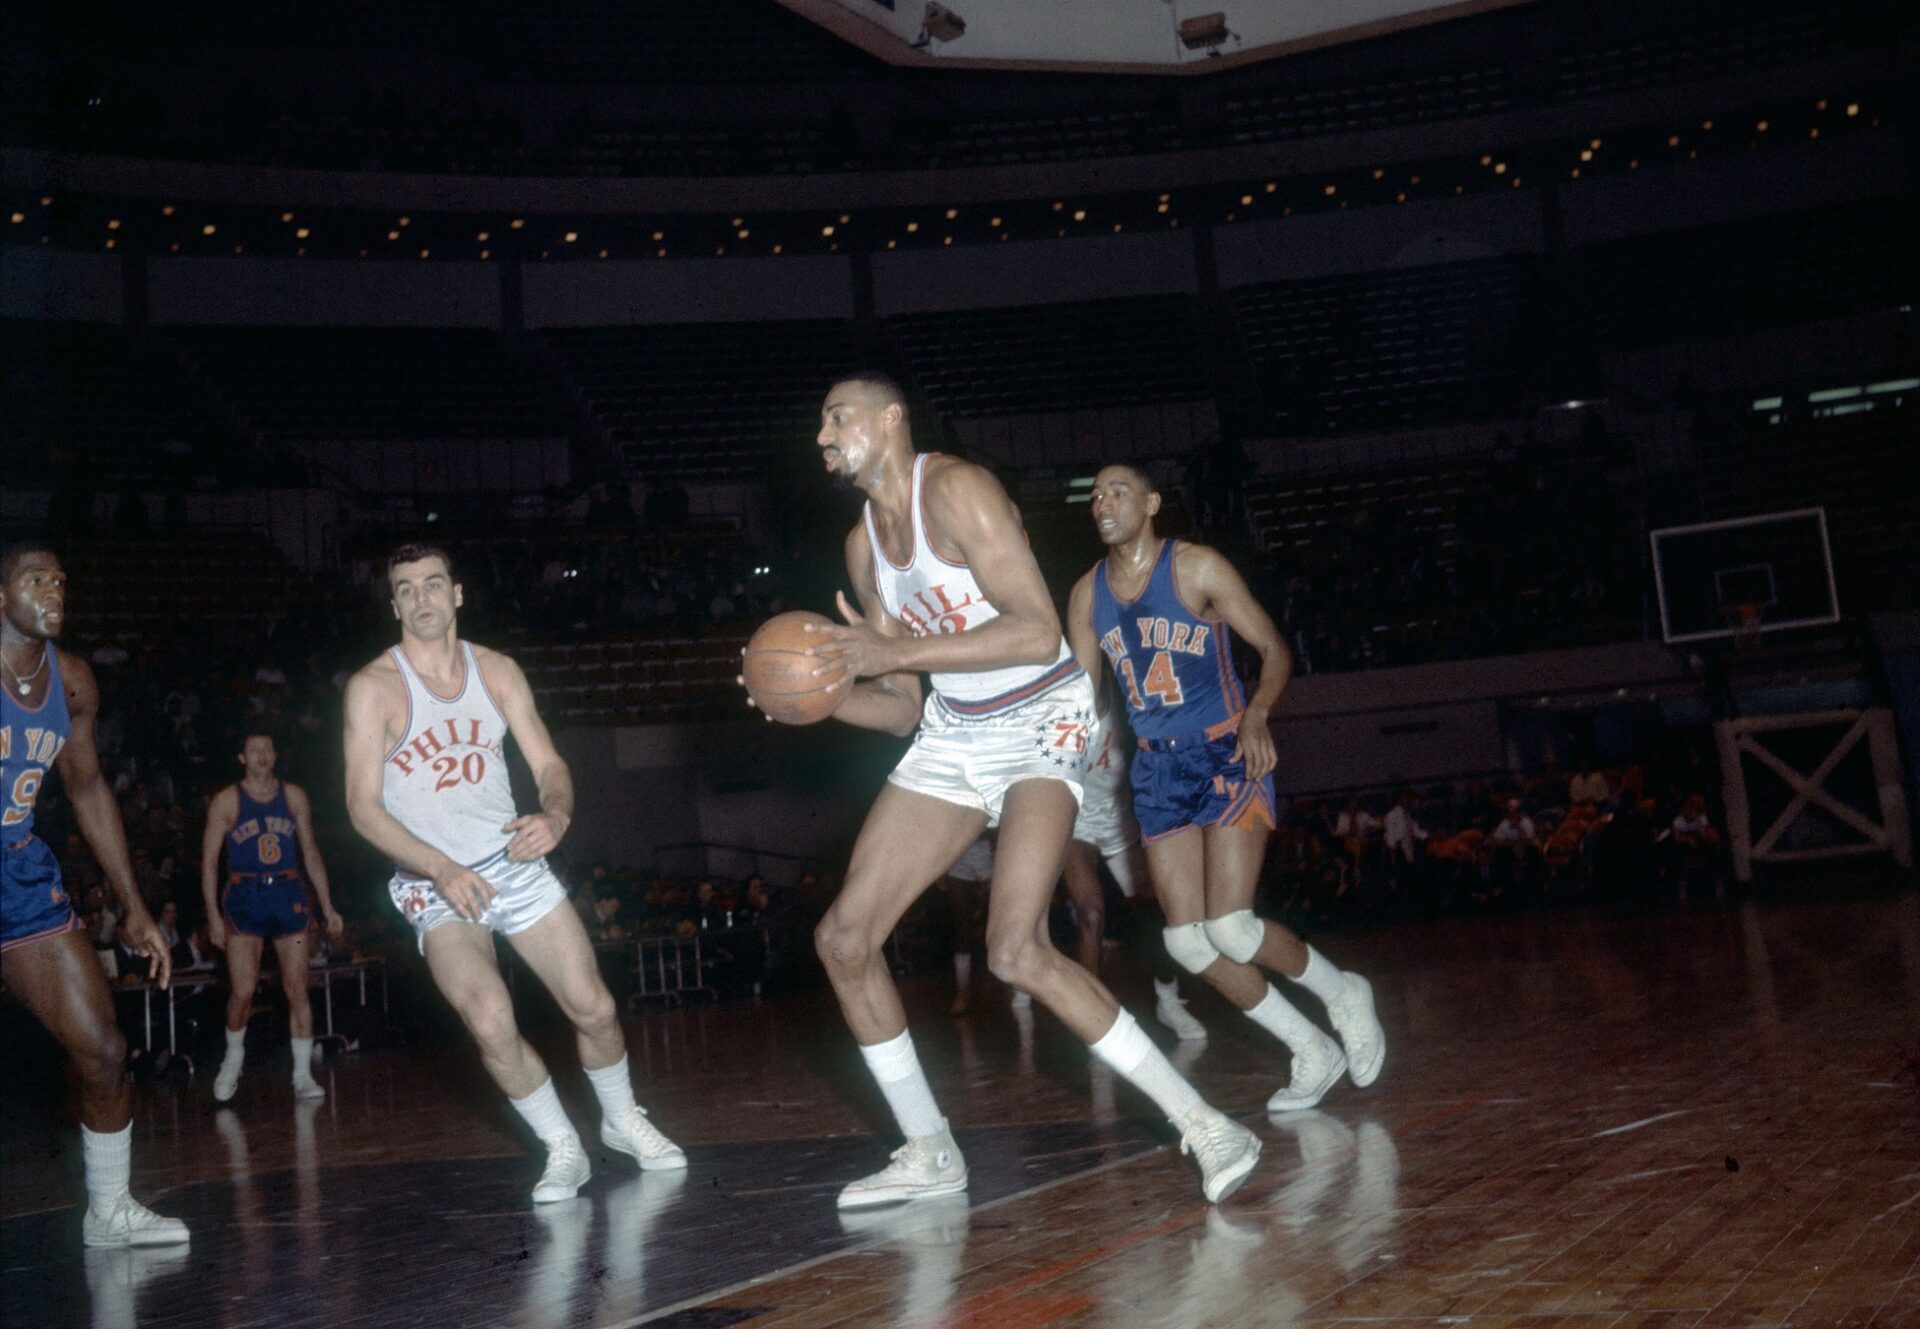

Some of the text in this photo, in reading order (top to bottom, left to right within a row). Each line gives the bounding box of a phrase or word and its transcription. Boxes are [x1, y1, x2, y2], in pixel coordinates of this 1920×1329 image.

[1137, 617, 1209, 655] YORK
[1121, 651, 1184, 710] 14
[432, 751, 486, 793] 20
[1, 766, 44, 826] 9
[258, 833, 281, 865] 6
